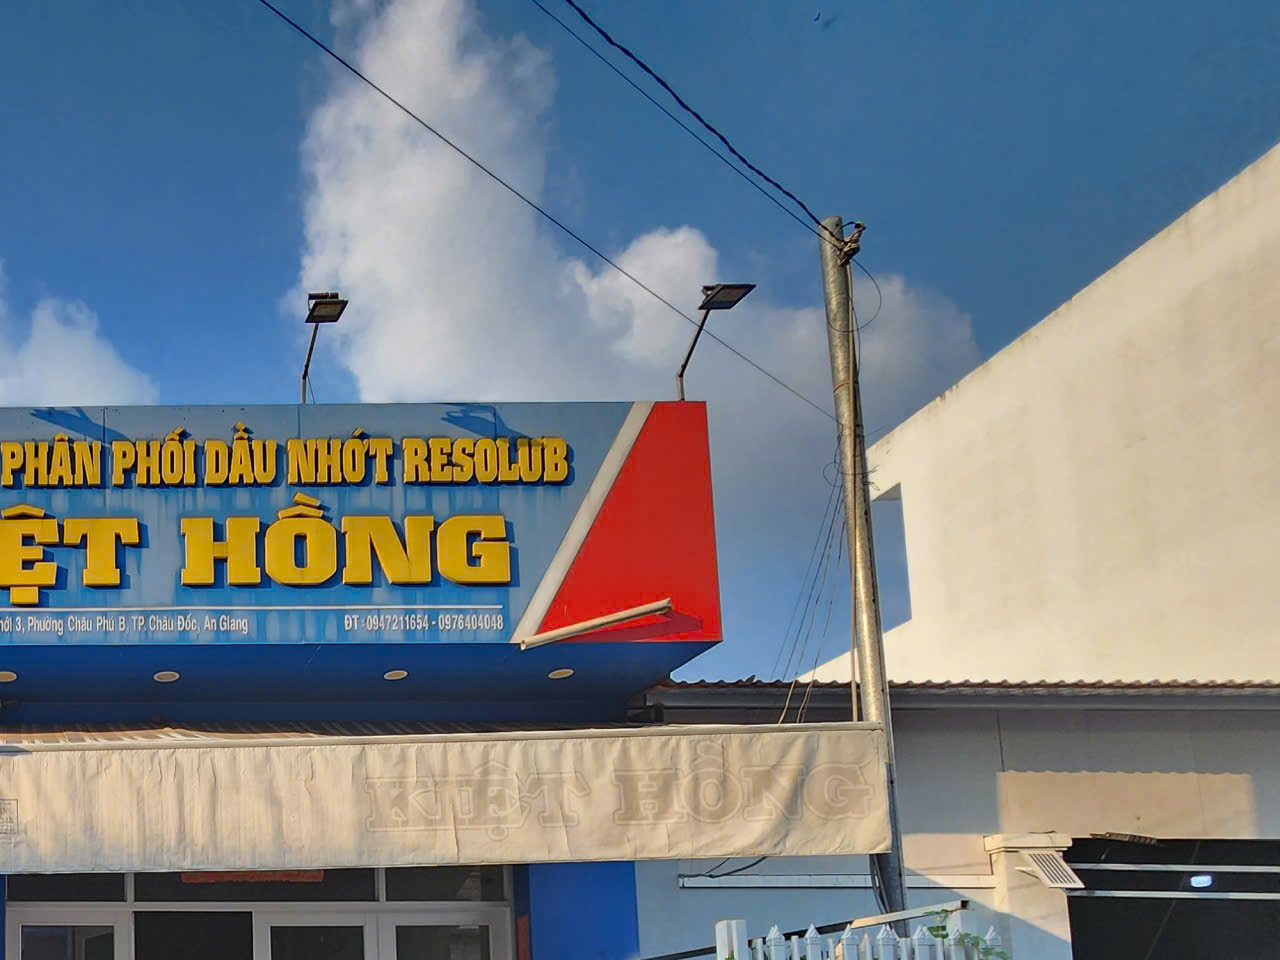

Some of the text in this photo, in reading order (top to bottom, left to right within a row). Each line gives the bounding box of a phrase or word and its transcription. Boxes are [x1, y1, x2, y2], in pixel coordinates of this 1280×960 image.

[0, 433, 101, 487] PHÂN
[112, 426, 196, 486] PHỐI
[204, 422, 277, 486] DẦU
[287, 427, 393, 485] NHỚT
[403, 437, 569, 484] RESOLUB
[180, 492, 511, 586] HỒNG
[27, 615, 64, 636] Phường
[67, 615, 93, 632] Châu
[96, 615, 115, 632] Phú
[149, 614, 174, 632] Châu
[203, 615, 217, 632] An
[219, 614, 249, 635] Giang
[438, 614, 504, 631] 0976404048
